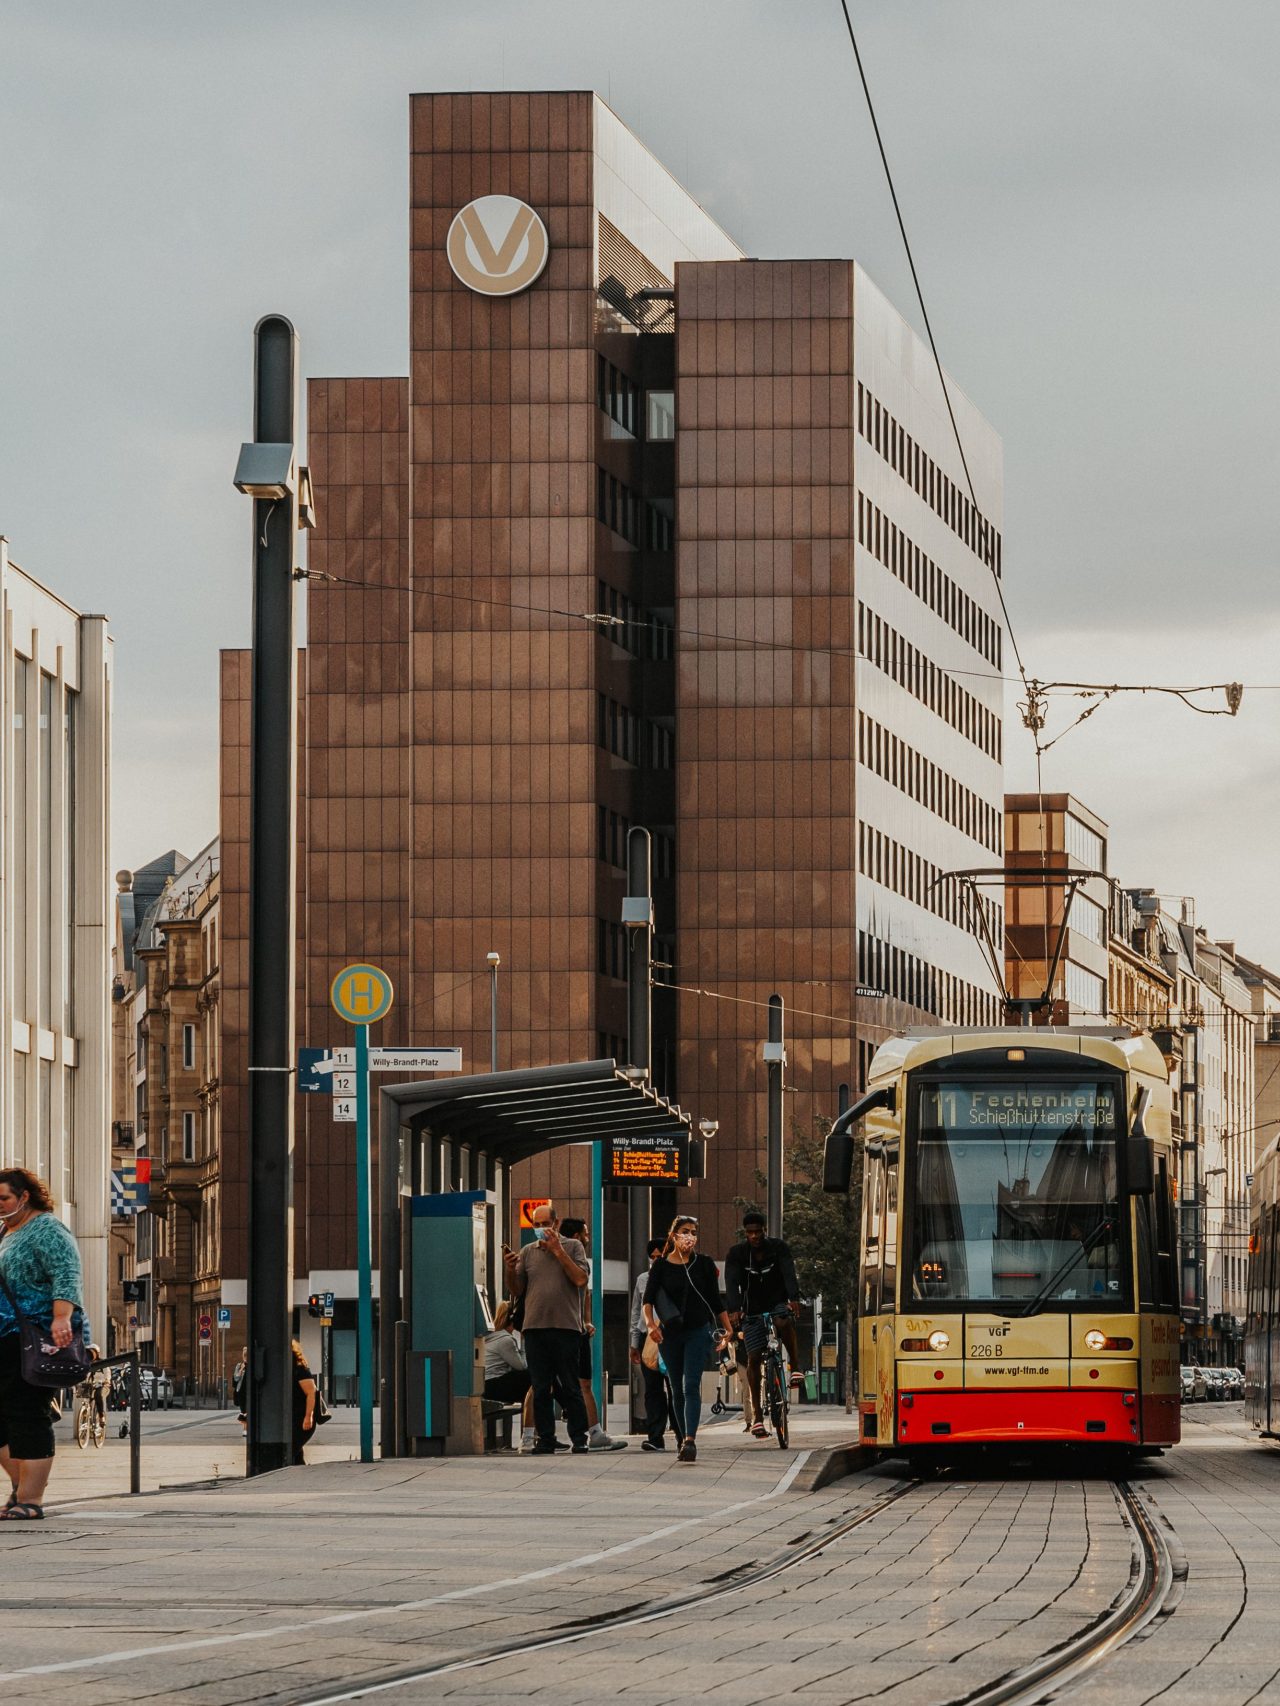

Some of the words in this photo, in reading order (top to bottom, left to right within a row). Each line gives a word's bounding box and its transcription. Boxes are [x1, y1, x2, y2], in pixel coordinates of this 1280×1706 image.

[350, 978, 374, 1010] H
[337, 1053, 349, 1064] 11
[372, 1058, 440, 1068] Willy-Brandt-Platz
[337, 1079, 350, 1089] 12
[971, 1092, 1112, 1108] Fechenheim
[337, 1103, 350, 1114] 14
[932, 1091, 957, 1127] 11
[969, 1108, 1115, 1127] Schießhüttenstraße
[612, 1137, 674, 1146] Willy-Brandt-Platz
[220, 1310, 229, 1320] P
[970, 1344, 993, 1358] 226
[995, 1344, 1003, 1357] B
[984, 1366, 1050, 1377] www.vgf-ffm.de
